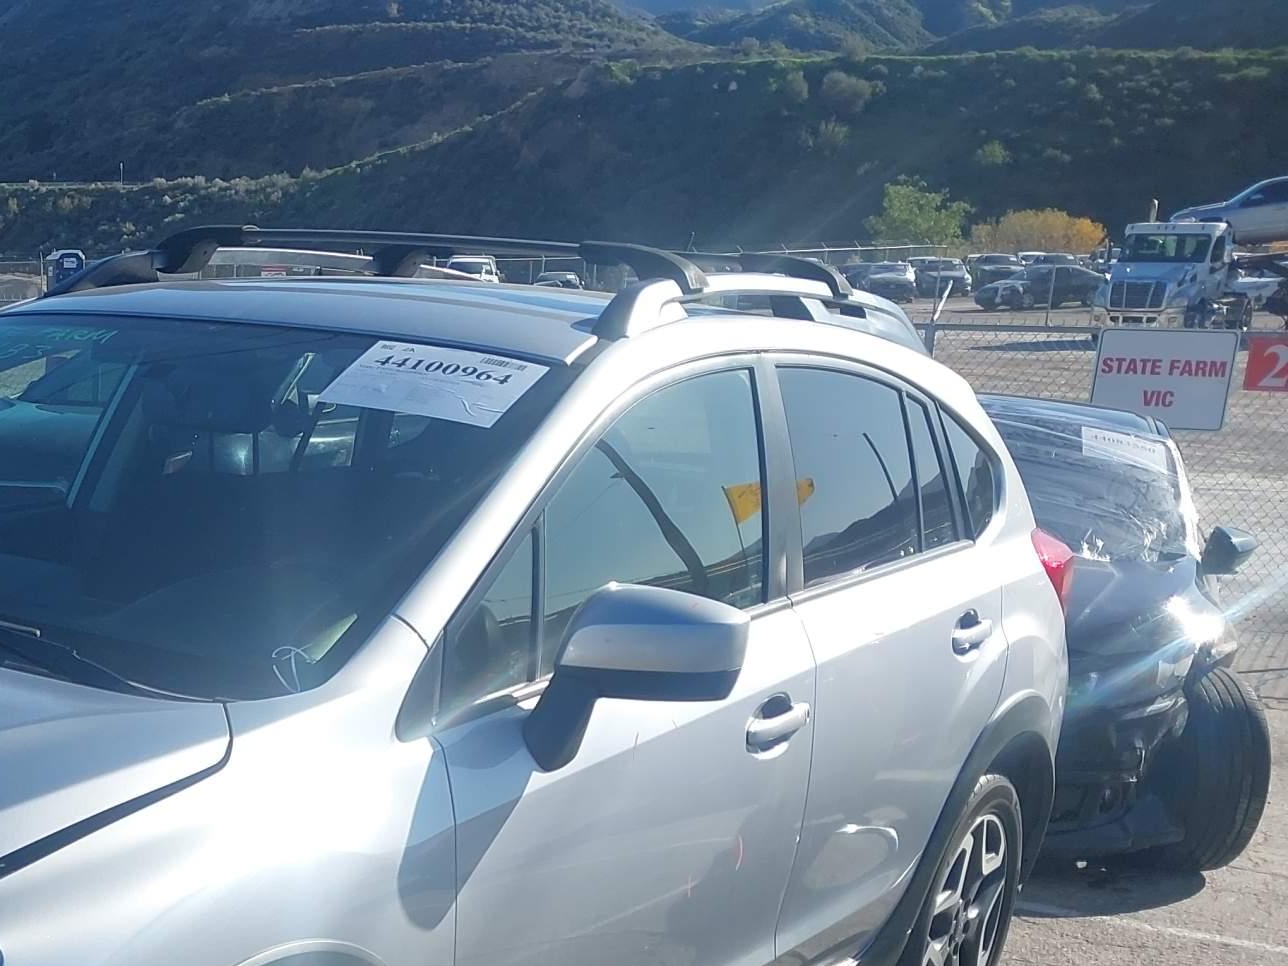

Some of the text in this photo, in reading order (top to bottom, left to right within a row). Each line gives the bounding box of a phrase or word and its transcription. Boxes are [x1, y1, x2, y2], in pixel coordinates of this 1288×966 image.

[374, 354, 513, 385] 44100964
[1101, 357, 1228, 378] STATE FARM
[1142, 389, 1176, 408] VIC
